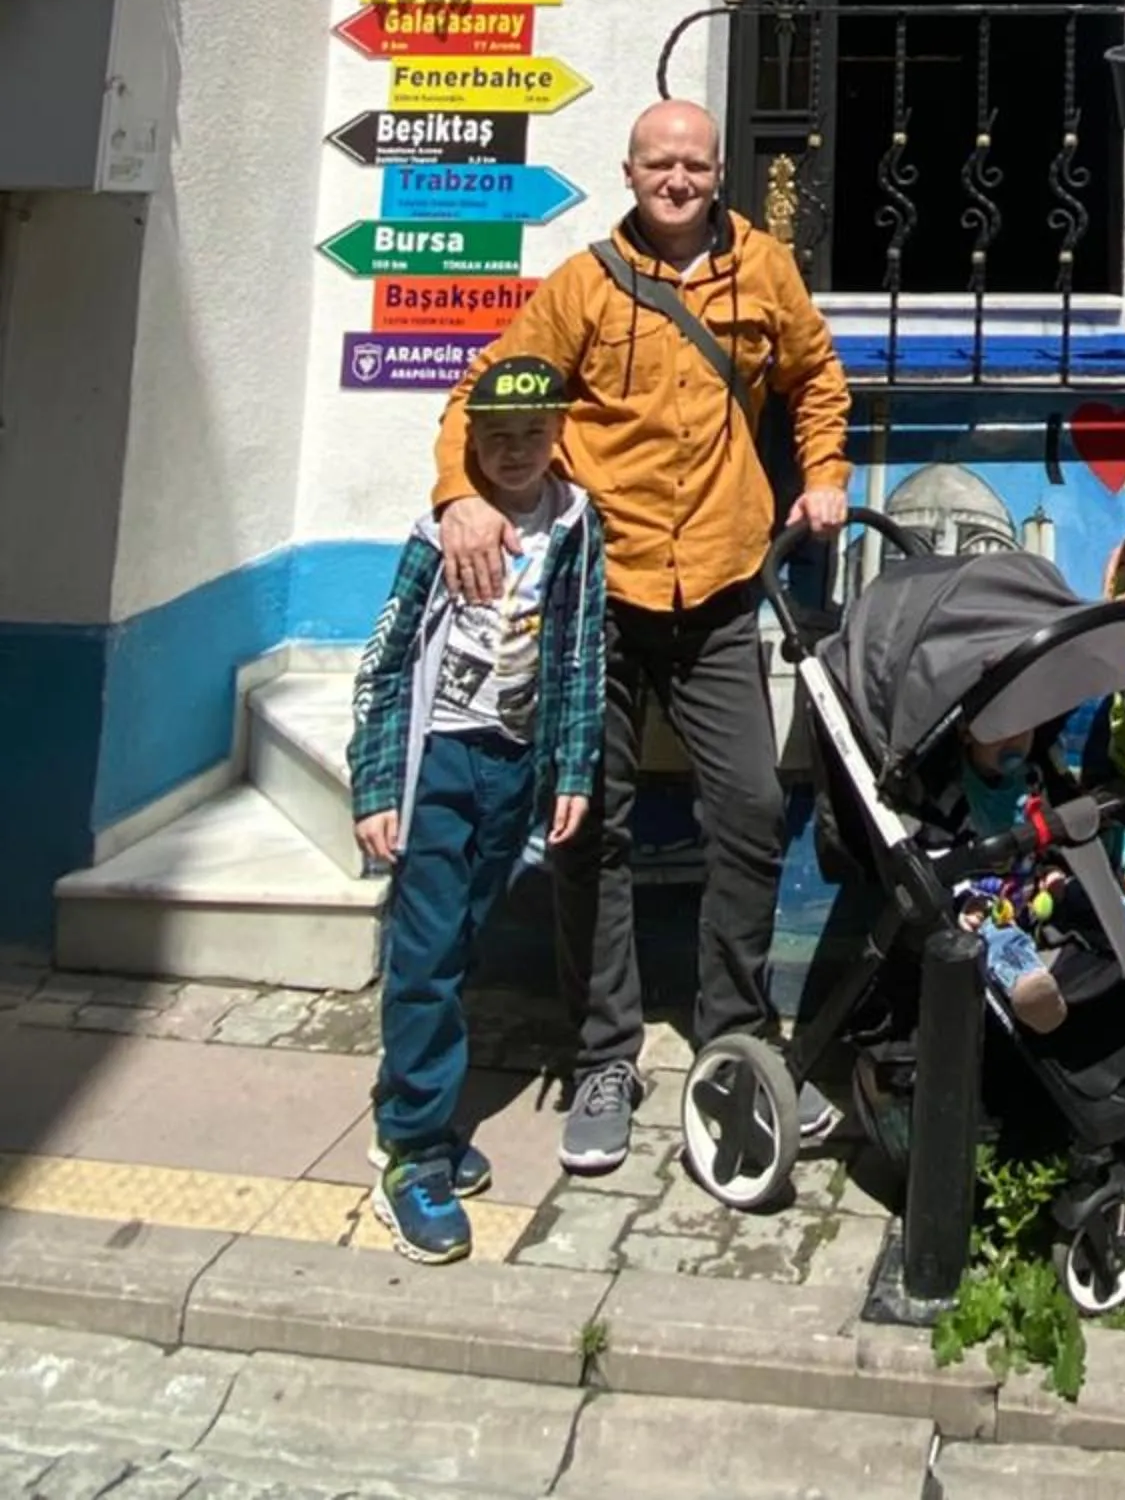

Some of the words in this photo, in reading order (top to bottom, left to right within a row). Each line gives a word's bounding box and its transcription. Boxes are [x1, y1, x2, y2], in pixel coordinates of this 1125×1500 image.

[385, 7, 525, 39] Galatasaray
[395, 66, 553, 90] Fenerbahçe
[377, 113, 494, 148] Beşiktaş
[400, 169, 513, 192] Trabzon
[375, 227, 464, 252] Bursa
[385, 344, 463, 364] ARAPGİR
[495, 372, 550, 396] BOY
